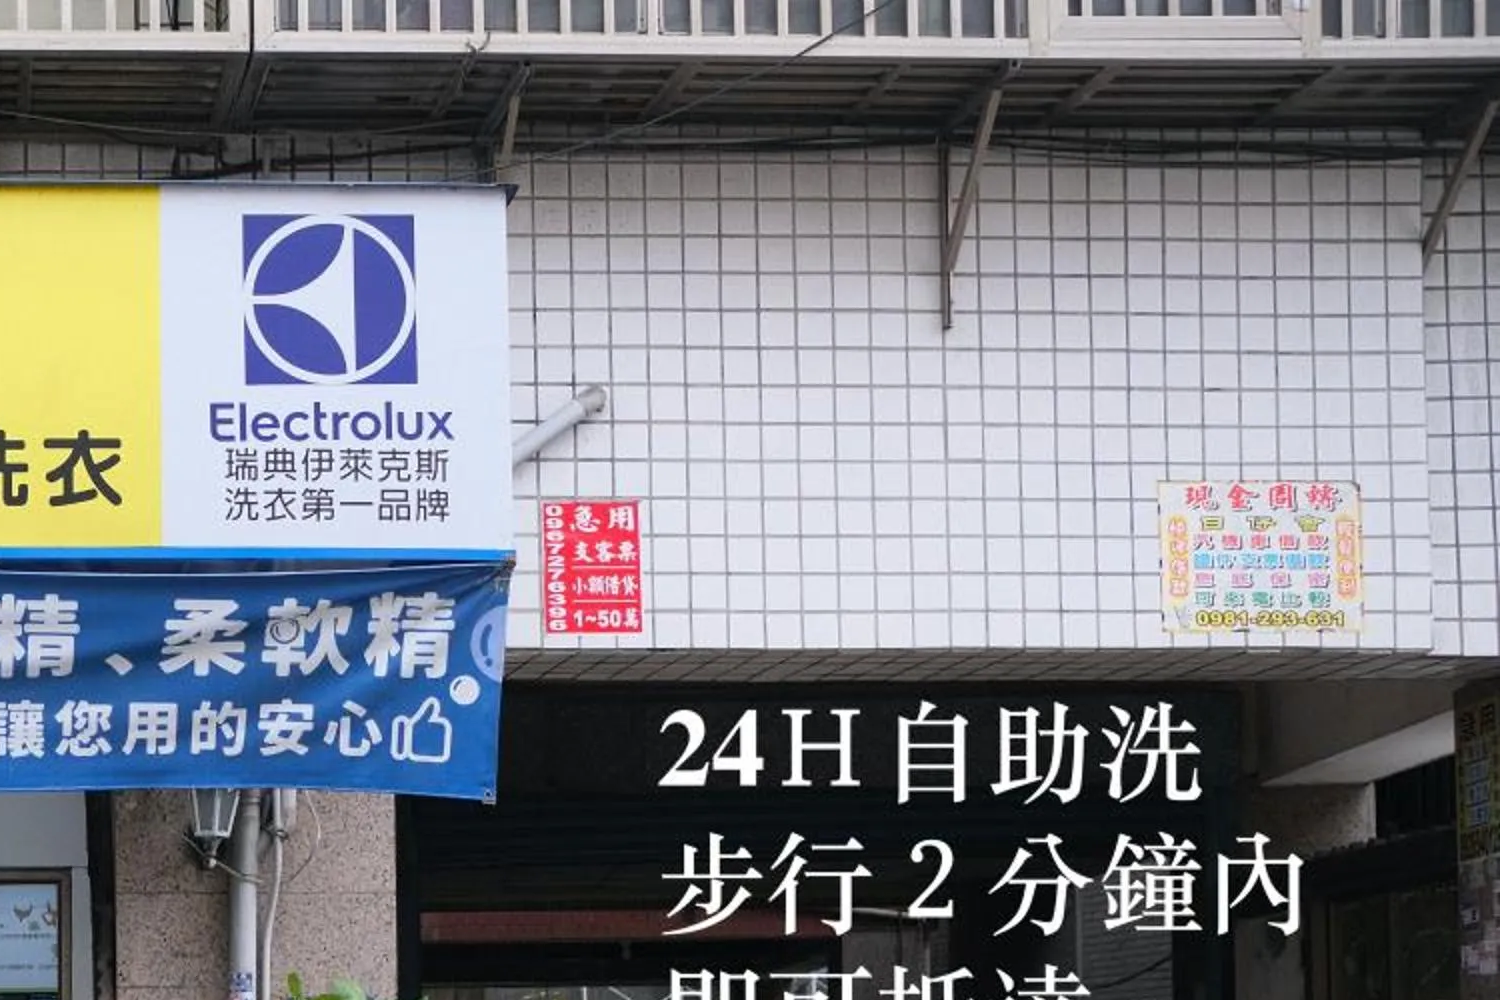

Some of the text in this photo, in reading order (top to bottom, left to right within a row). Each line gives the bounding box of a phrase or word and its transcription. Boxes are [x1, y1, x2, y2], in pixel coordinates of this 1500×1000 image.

[209, 401, 455, 442] Electrolux
[225, 447, 450, 483] 瑞典伊萊克斯
[225, 487, 450, 522] 洗衣第一品牌
[1195, 609, 1346, 628] 0981-293-631
